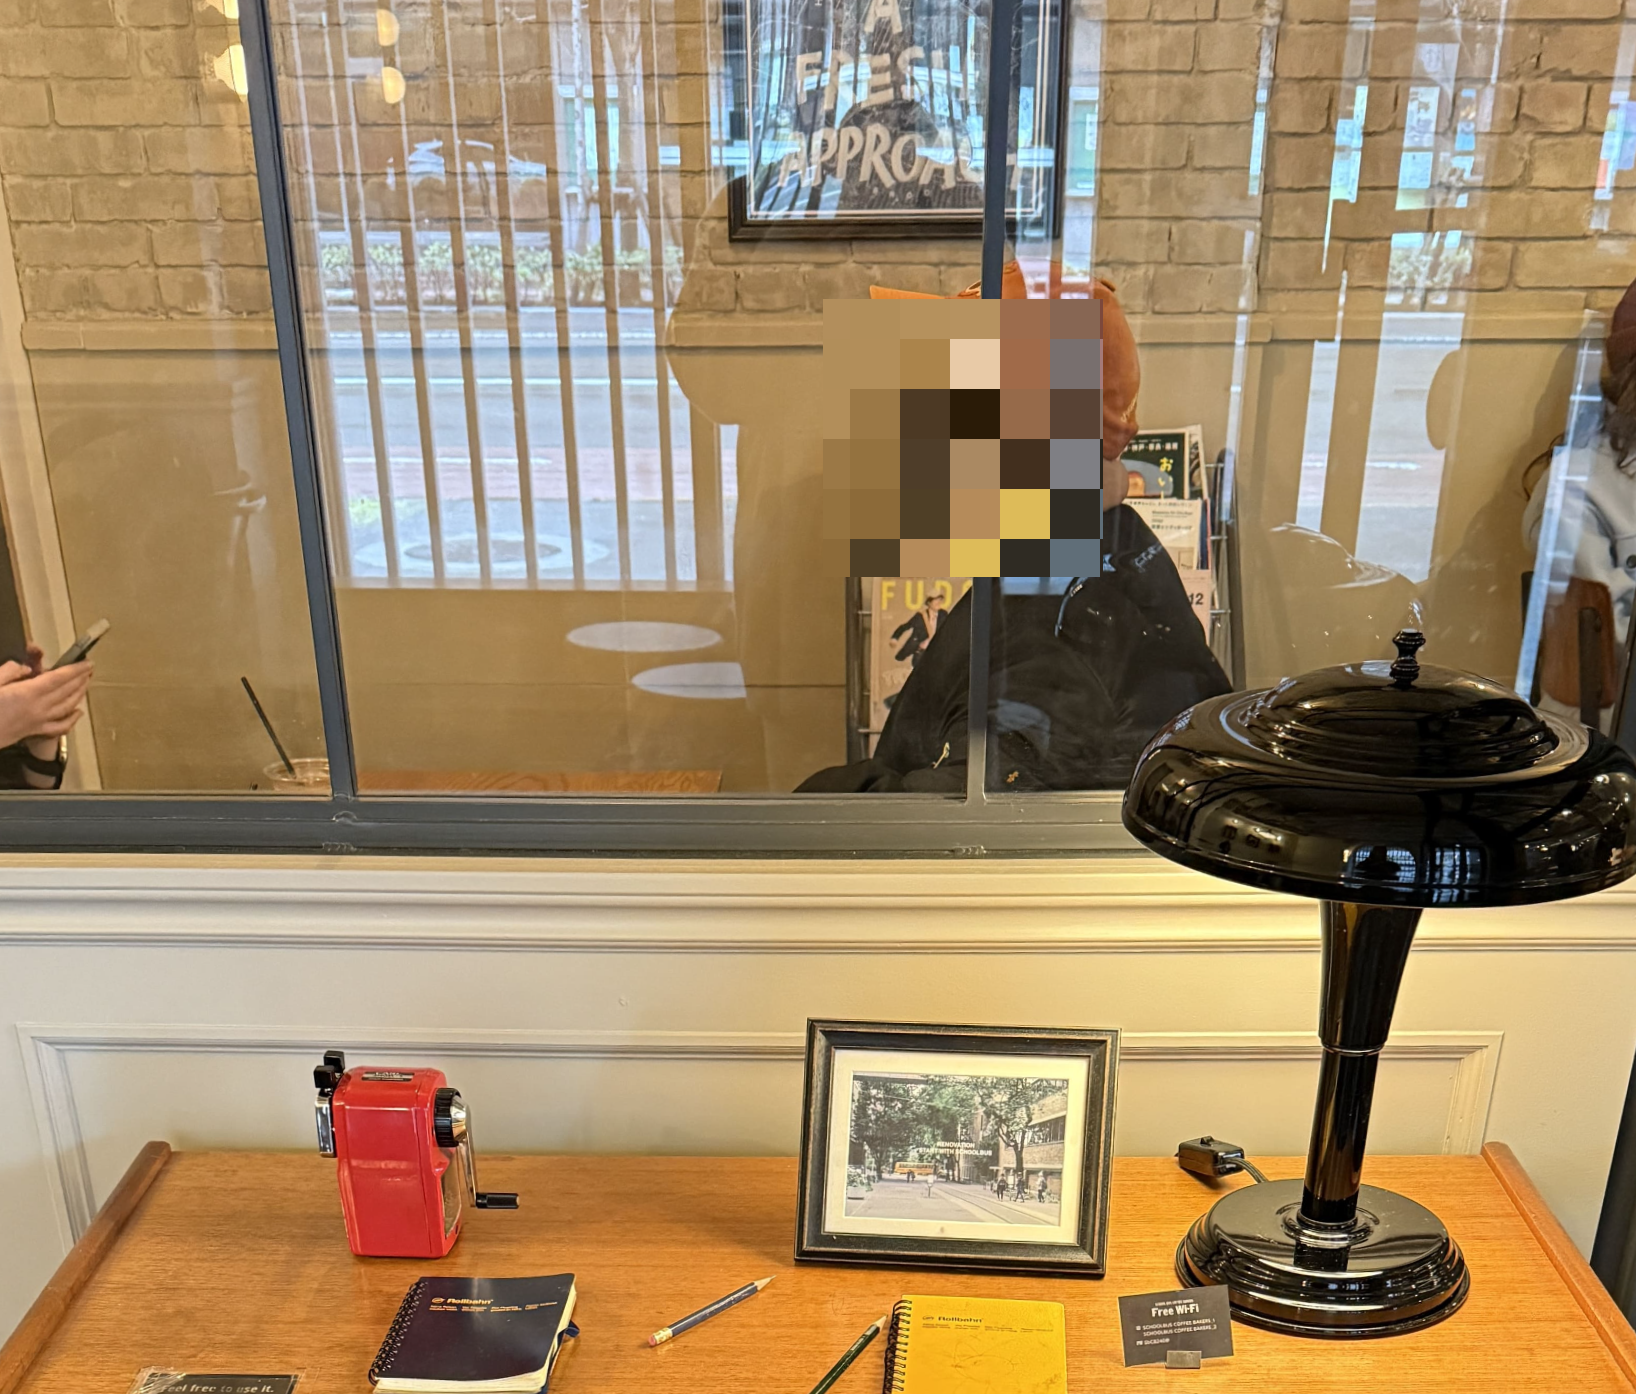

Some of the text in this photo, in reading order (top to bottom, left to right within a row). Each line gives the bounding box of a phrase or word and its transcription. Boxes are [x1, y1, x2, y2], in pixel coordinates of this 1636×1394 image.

[936, 1141, 976, 1149] RENOVATION
[1151, 1303, 1200, 1318] Free Wi-Fi
